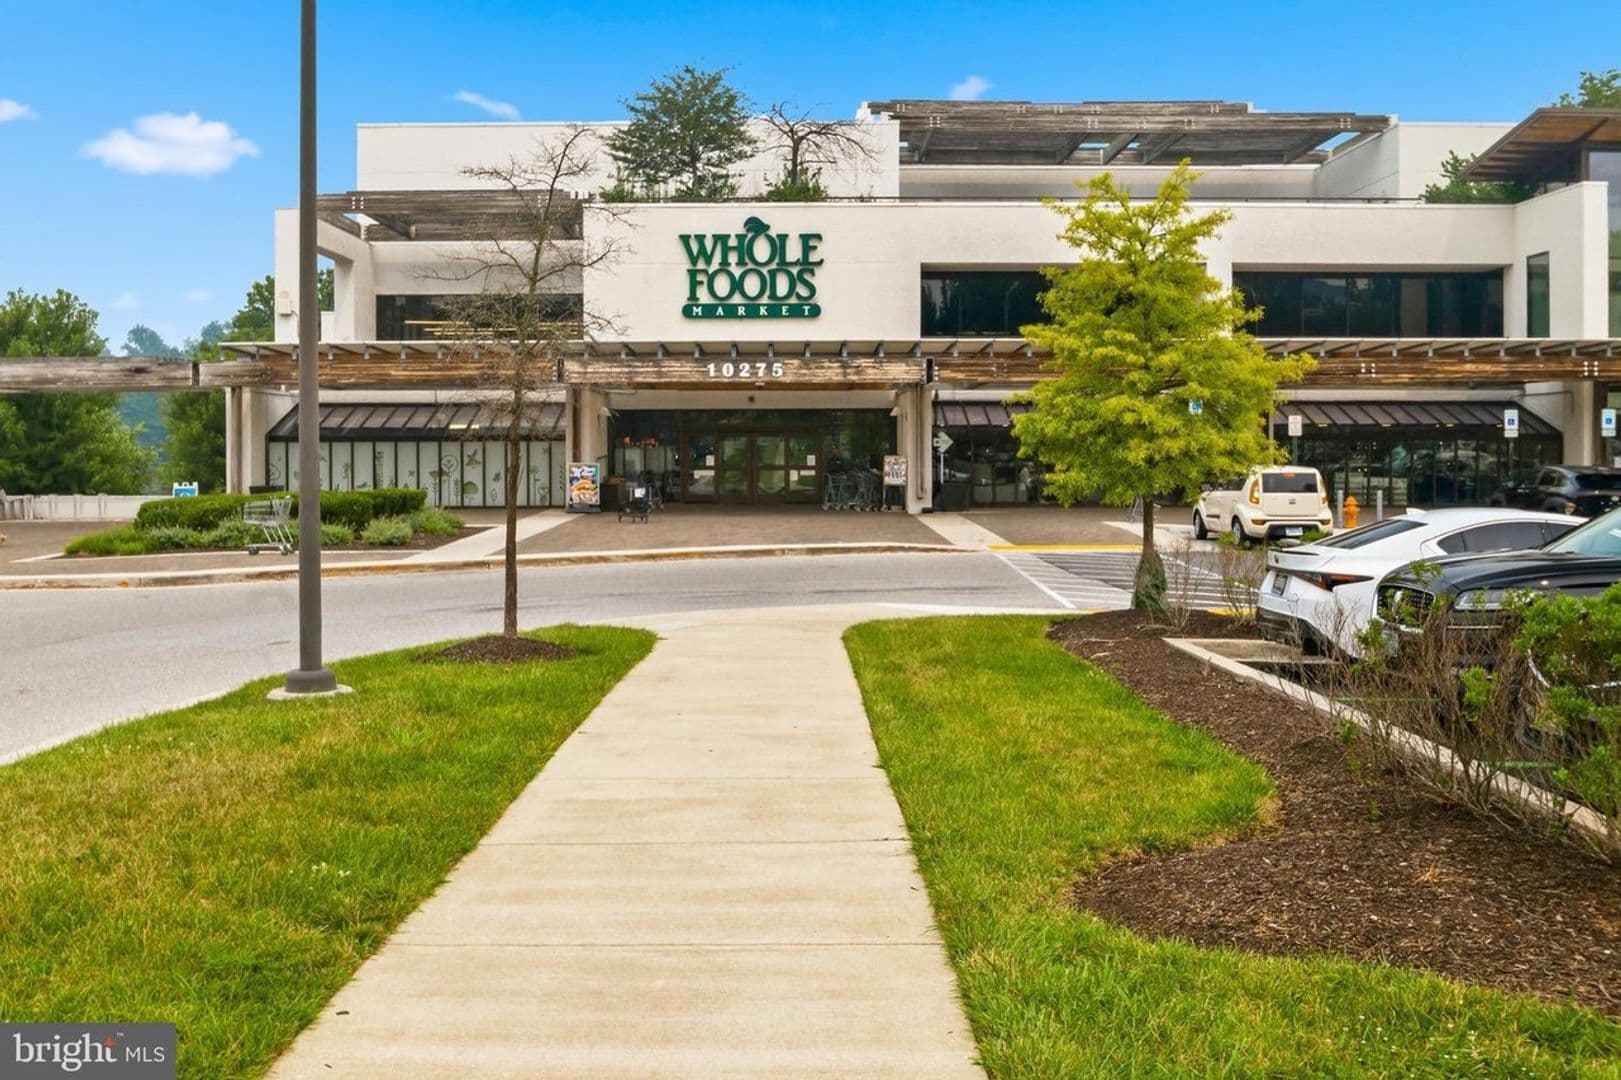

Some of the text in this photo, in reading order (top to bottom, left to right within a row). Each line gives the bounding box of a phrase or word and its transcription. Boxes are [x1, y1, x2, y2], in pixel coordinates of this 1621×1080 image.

[678, 233, 824, 266] WHOLE
[686, 268, 817, 301] FOODS
[692, 306, 811, 316] MARKET
[707, 362, 784, 377] 10275
